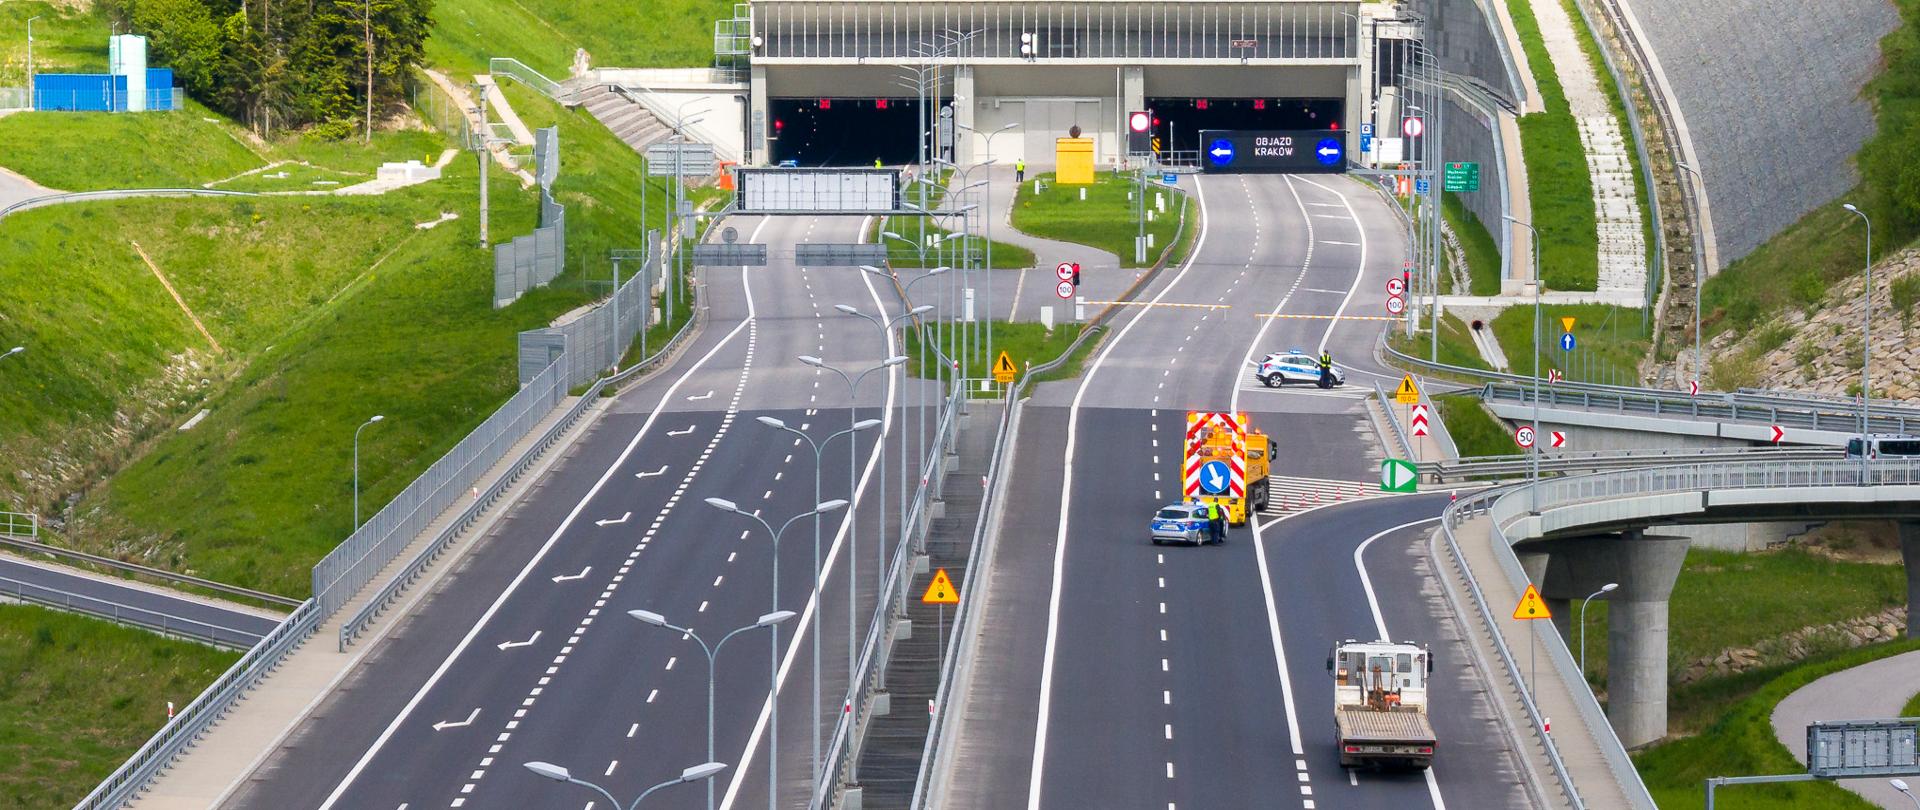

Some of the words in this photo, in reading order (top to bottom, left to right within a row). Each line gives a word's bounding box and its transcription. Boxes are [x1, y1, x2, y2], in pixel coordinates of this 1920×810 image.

[1255, 137, 1292, 146] OBJAZD
[1254, 146, 1293, 156] KRAKÓW
[1520, 431, 1533, 442] 50
